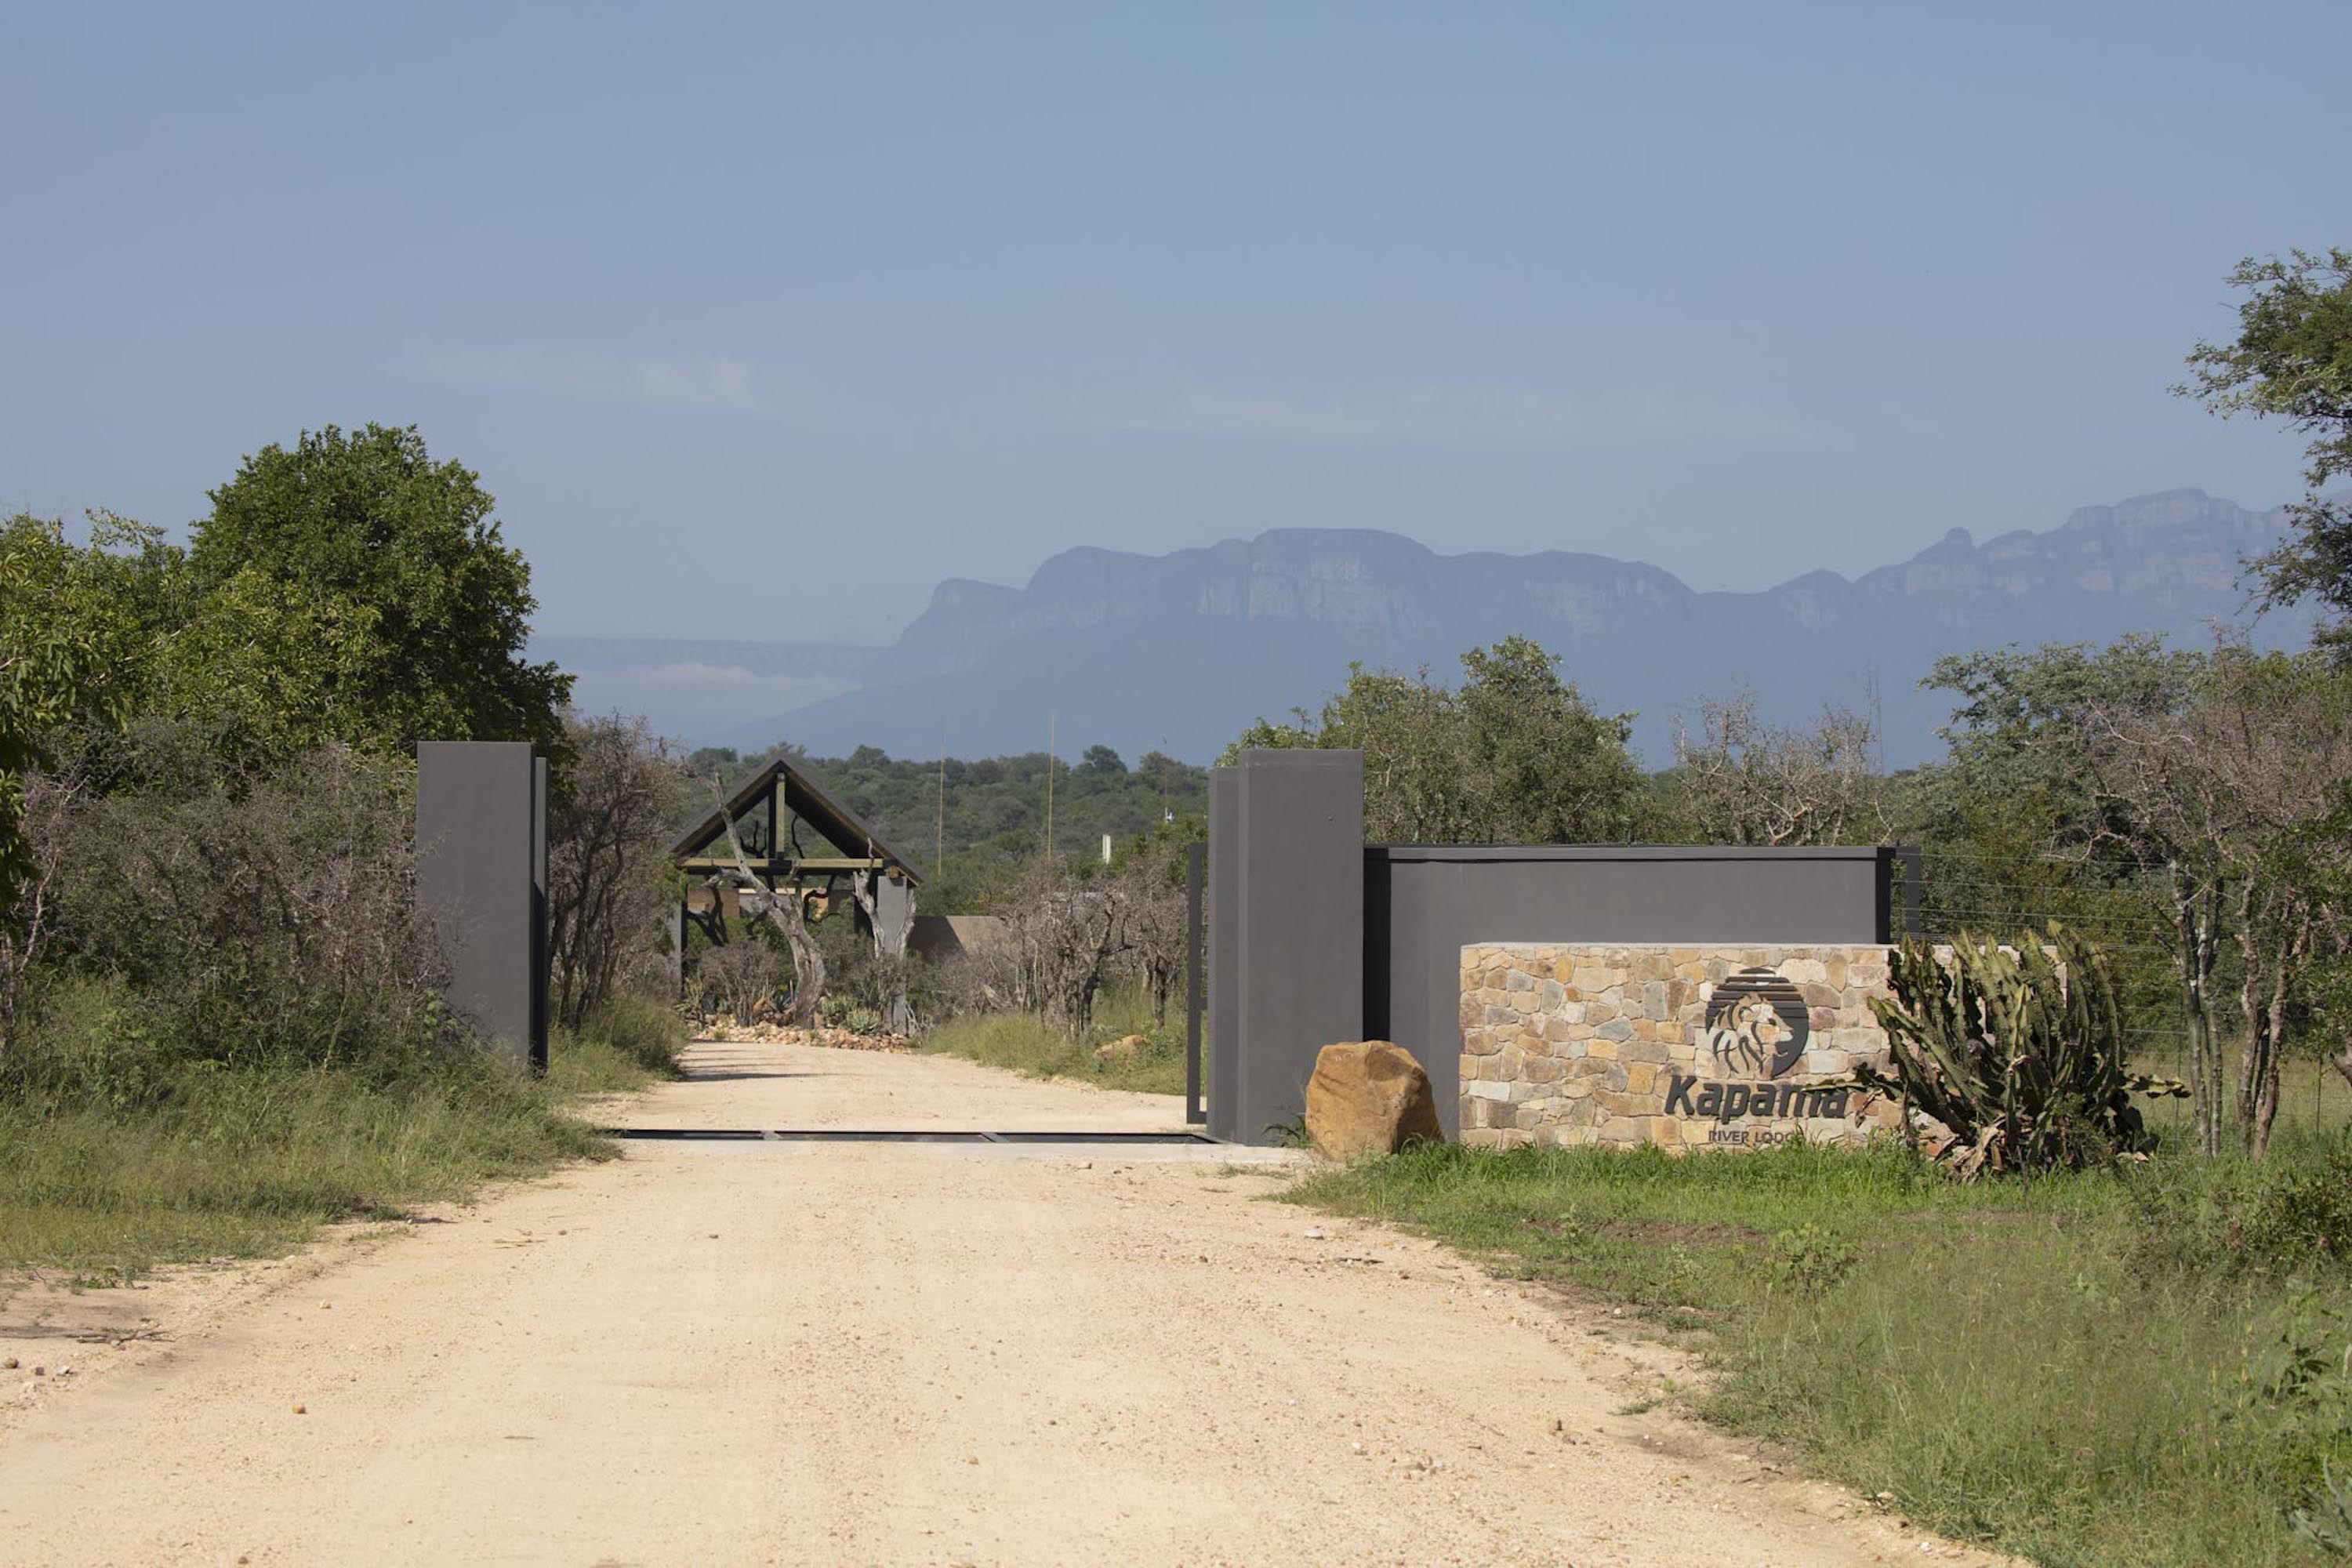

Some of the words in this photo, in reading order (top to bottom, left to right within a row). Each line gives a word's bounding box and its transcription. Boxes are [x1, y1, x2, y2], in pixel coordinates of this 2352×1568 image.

[1664, 1075, 1849, 1125] Kapama
[1708, 1130, 1749, 1142] RIVER
[1755, 1131, 1802, 1144] LODG
